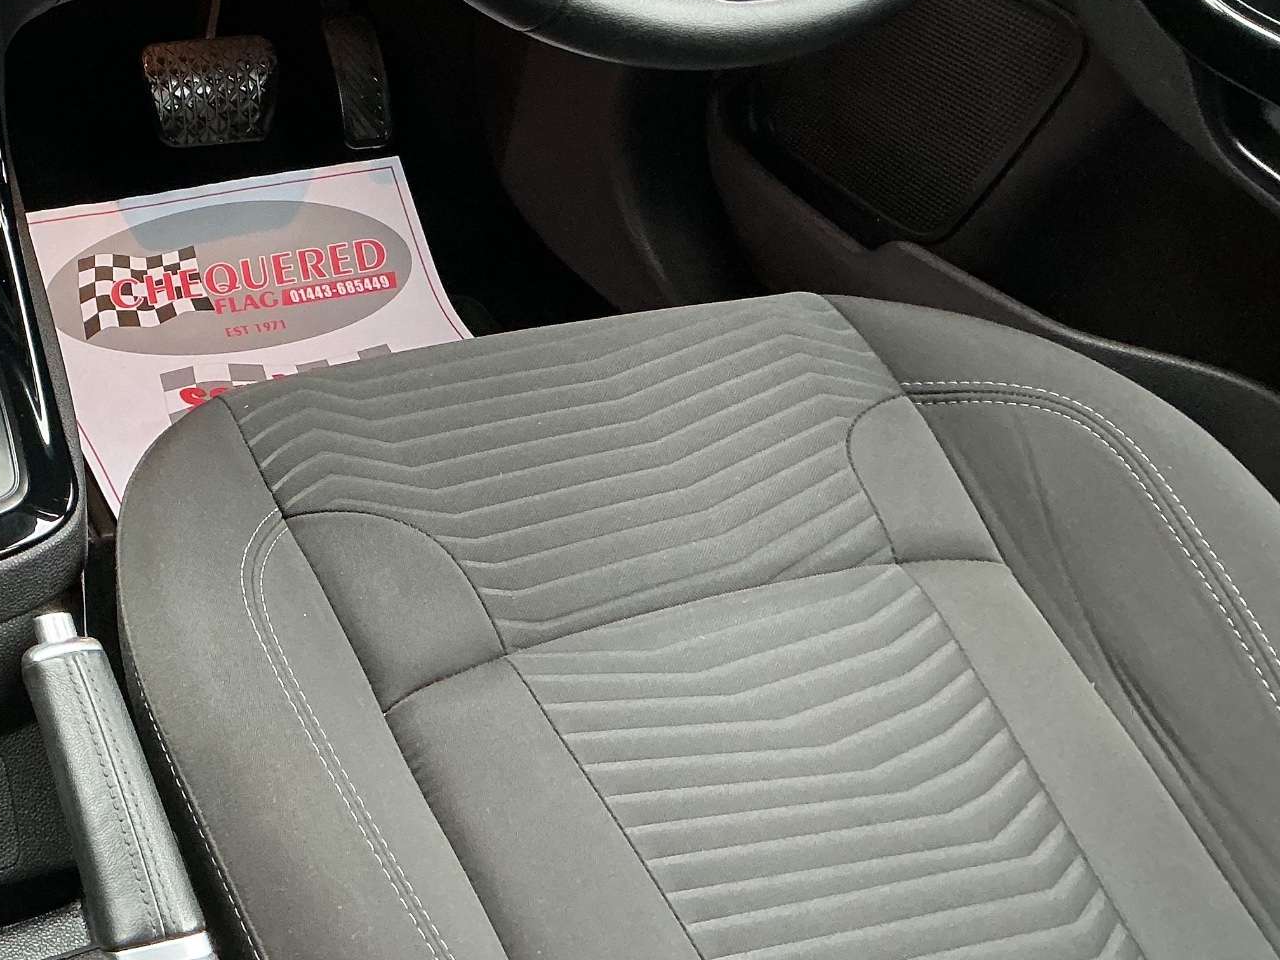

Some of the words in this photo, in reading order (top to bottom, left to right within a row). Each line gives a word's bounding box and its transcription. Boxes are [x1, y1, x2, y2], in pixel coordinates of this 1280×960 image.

[110, 238, 388, 310] CHEQUERED
[288, 274, 391, 304] 01443-685449
[212, 291, 279, 315] FLAG
[224, 325, 251, 338] EST
[255, 319, 288, 334] 1971
